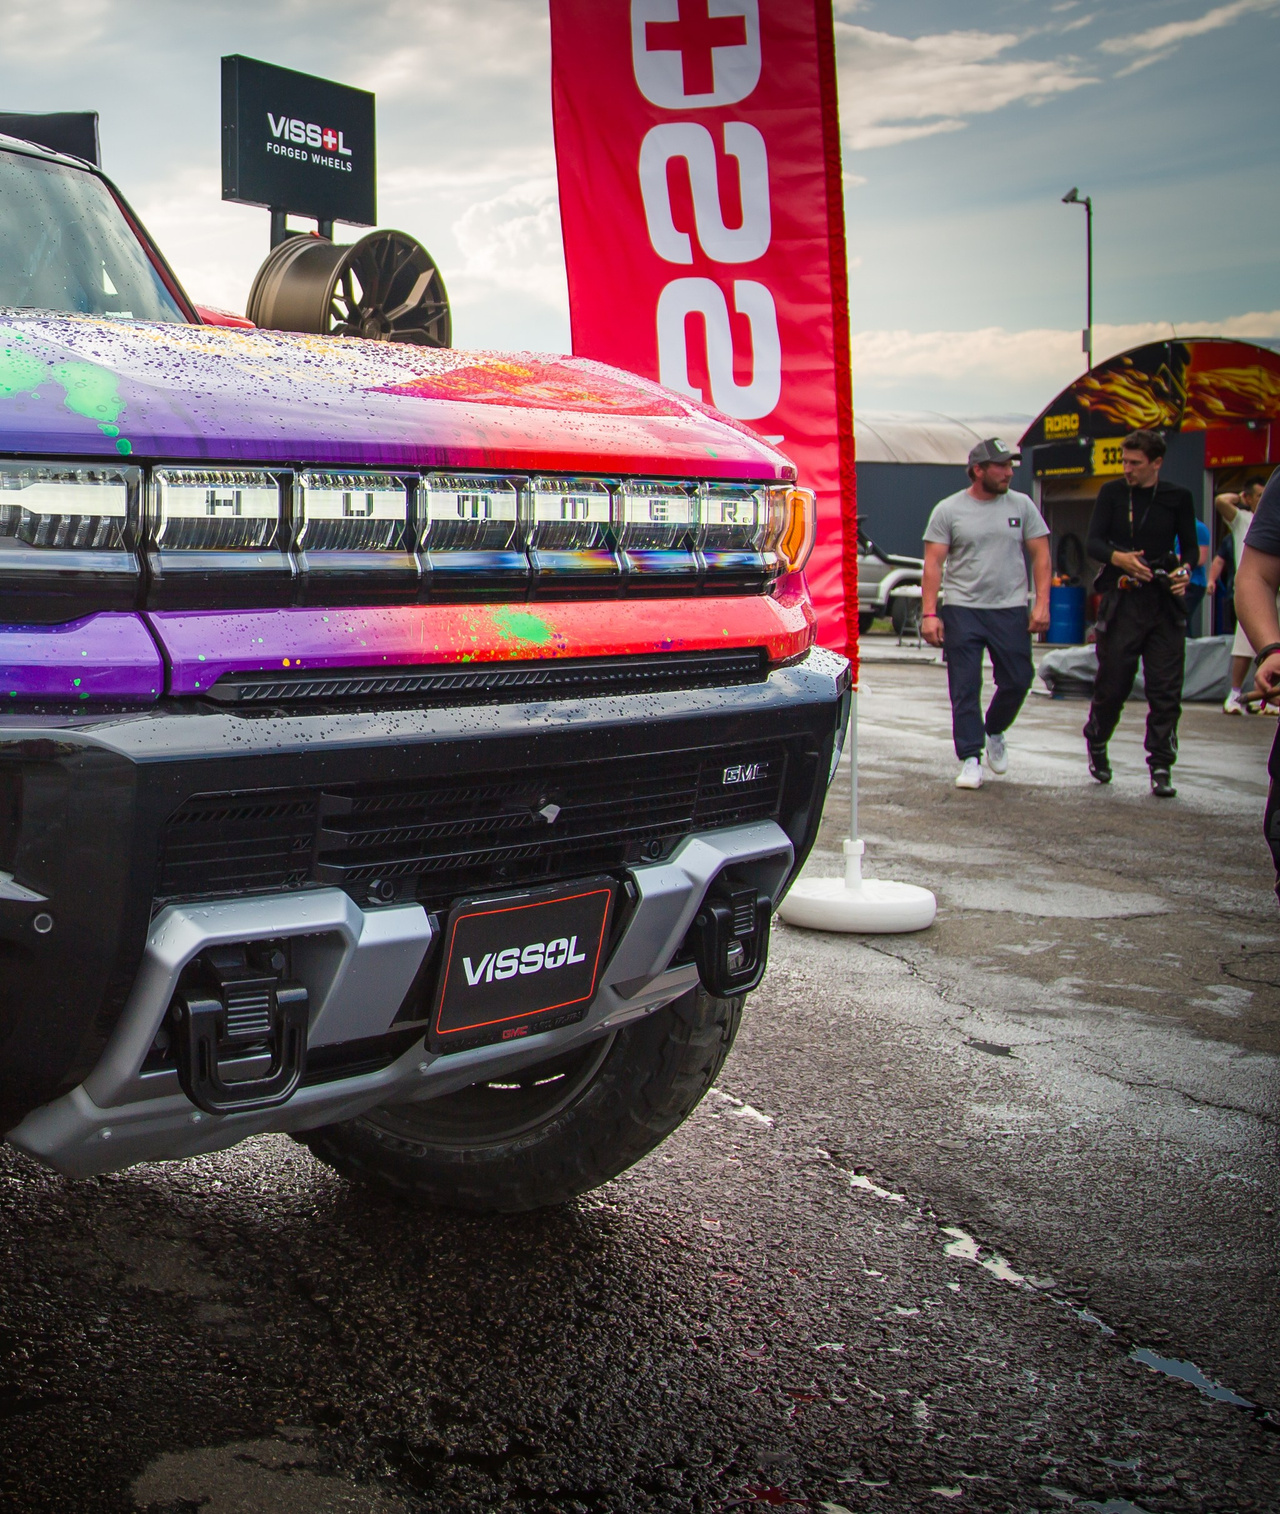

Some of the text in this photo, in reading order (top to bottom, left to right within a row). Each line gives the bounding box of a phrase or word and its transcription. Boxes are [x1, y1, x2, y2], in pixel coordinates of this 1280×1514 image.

[266, 112, 353, 156] VISSOL
[266, 142, 353, 173] FORGED WHEELS
[723, 763, 769, 784] GMC
[462, 935, 586, 987] VISSOL
[502, 1025, 529, 1040] GMC
